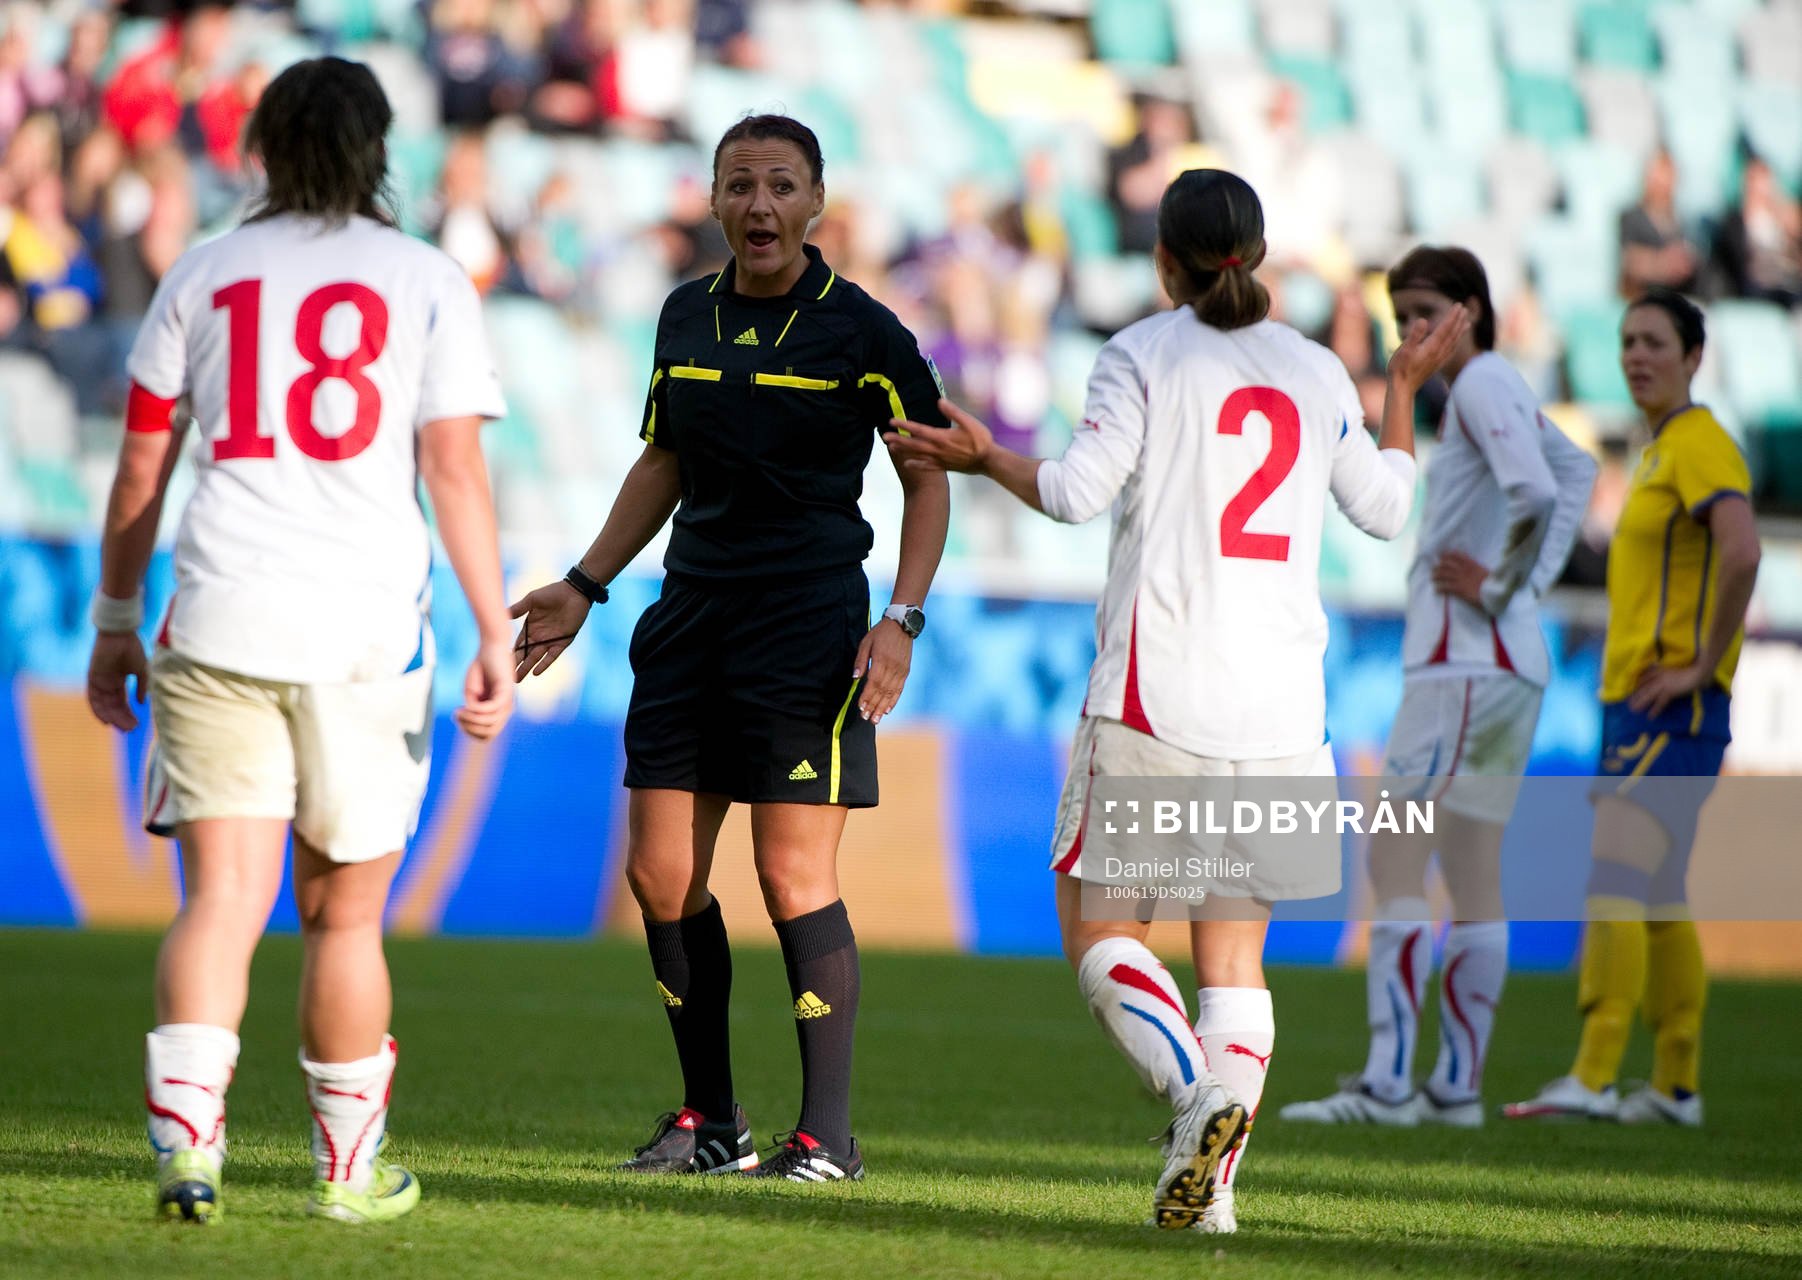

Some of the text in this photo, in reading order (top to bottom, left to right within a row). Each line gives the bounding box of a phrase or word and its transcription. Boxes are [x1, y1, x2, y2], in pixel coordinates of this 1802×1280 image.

[733, 338, 760, 346] adidas
[211, 278, 389, 461] 18
[1217, 385, 1301, 562] 2
[788, 771, 818, 780] adidas
[794, 1003, 832, 1020] didas
